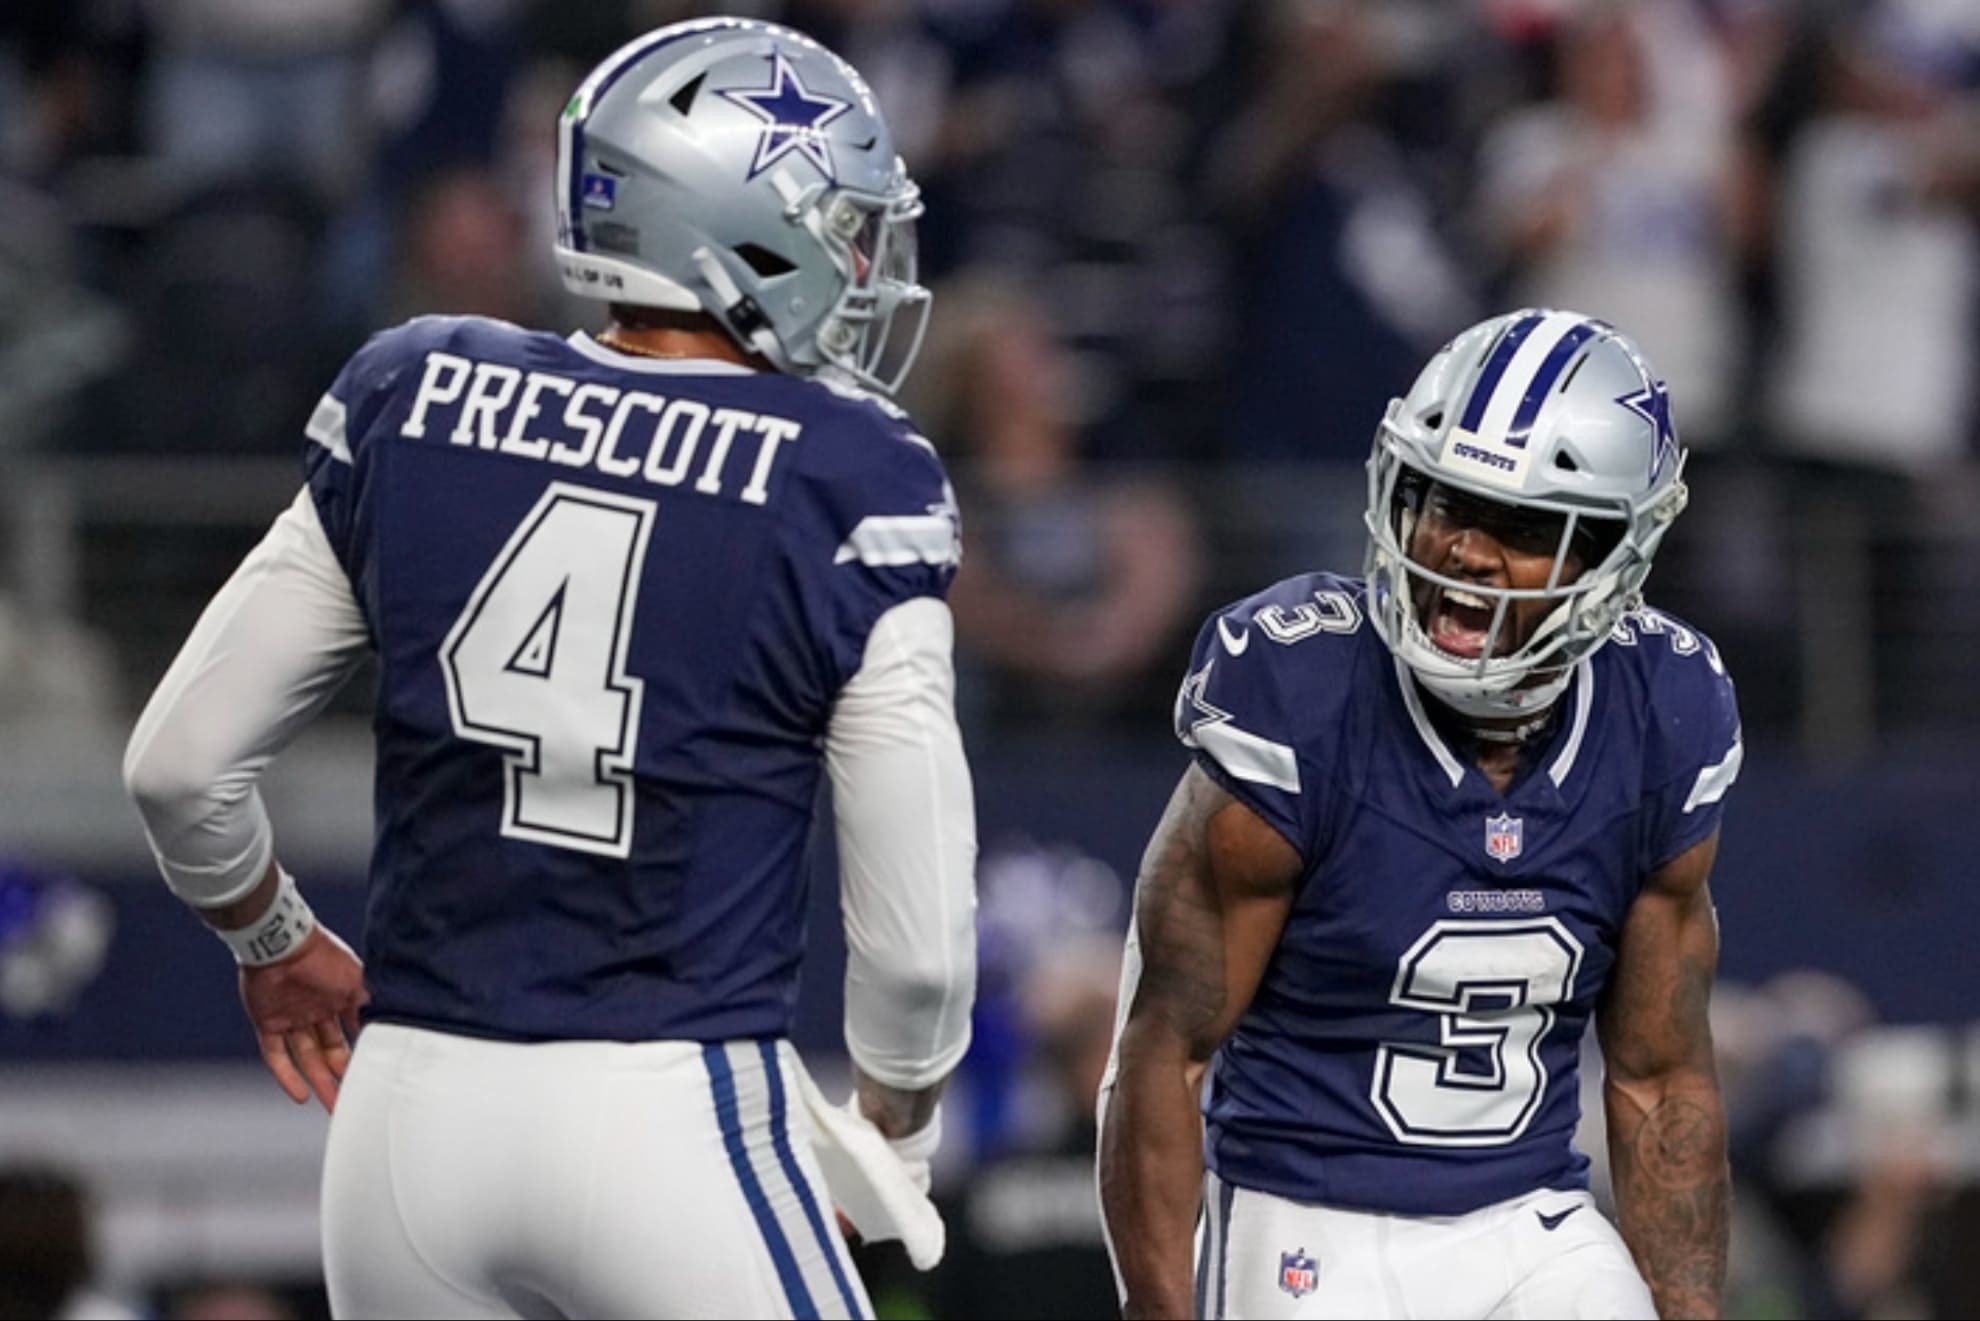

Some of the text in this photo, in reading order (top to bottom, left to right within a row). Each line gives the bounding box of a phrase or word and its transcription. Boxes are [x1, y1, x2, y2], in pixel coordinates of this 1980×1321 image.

[400, 352, 802, 506] PRESCOTT
[1453, 442, 1517, 473] COWBOYS
[1252, 590, 1364, 646] 3
[437, 480, 658, 859] 4
[1489, 833, 1519, 855] NFL
[1446, 889, 1546, 913] COWBOYS
[1370, 916, 1586, 1147] 3
[1285, 1268, 1313, 1289] NFL
